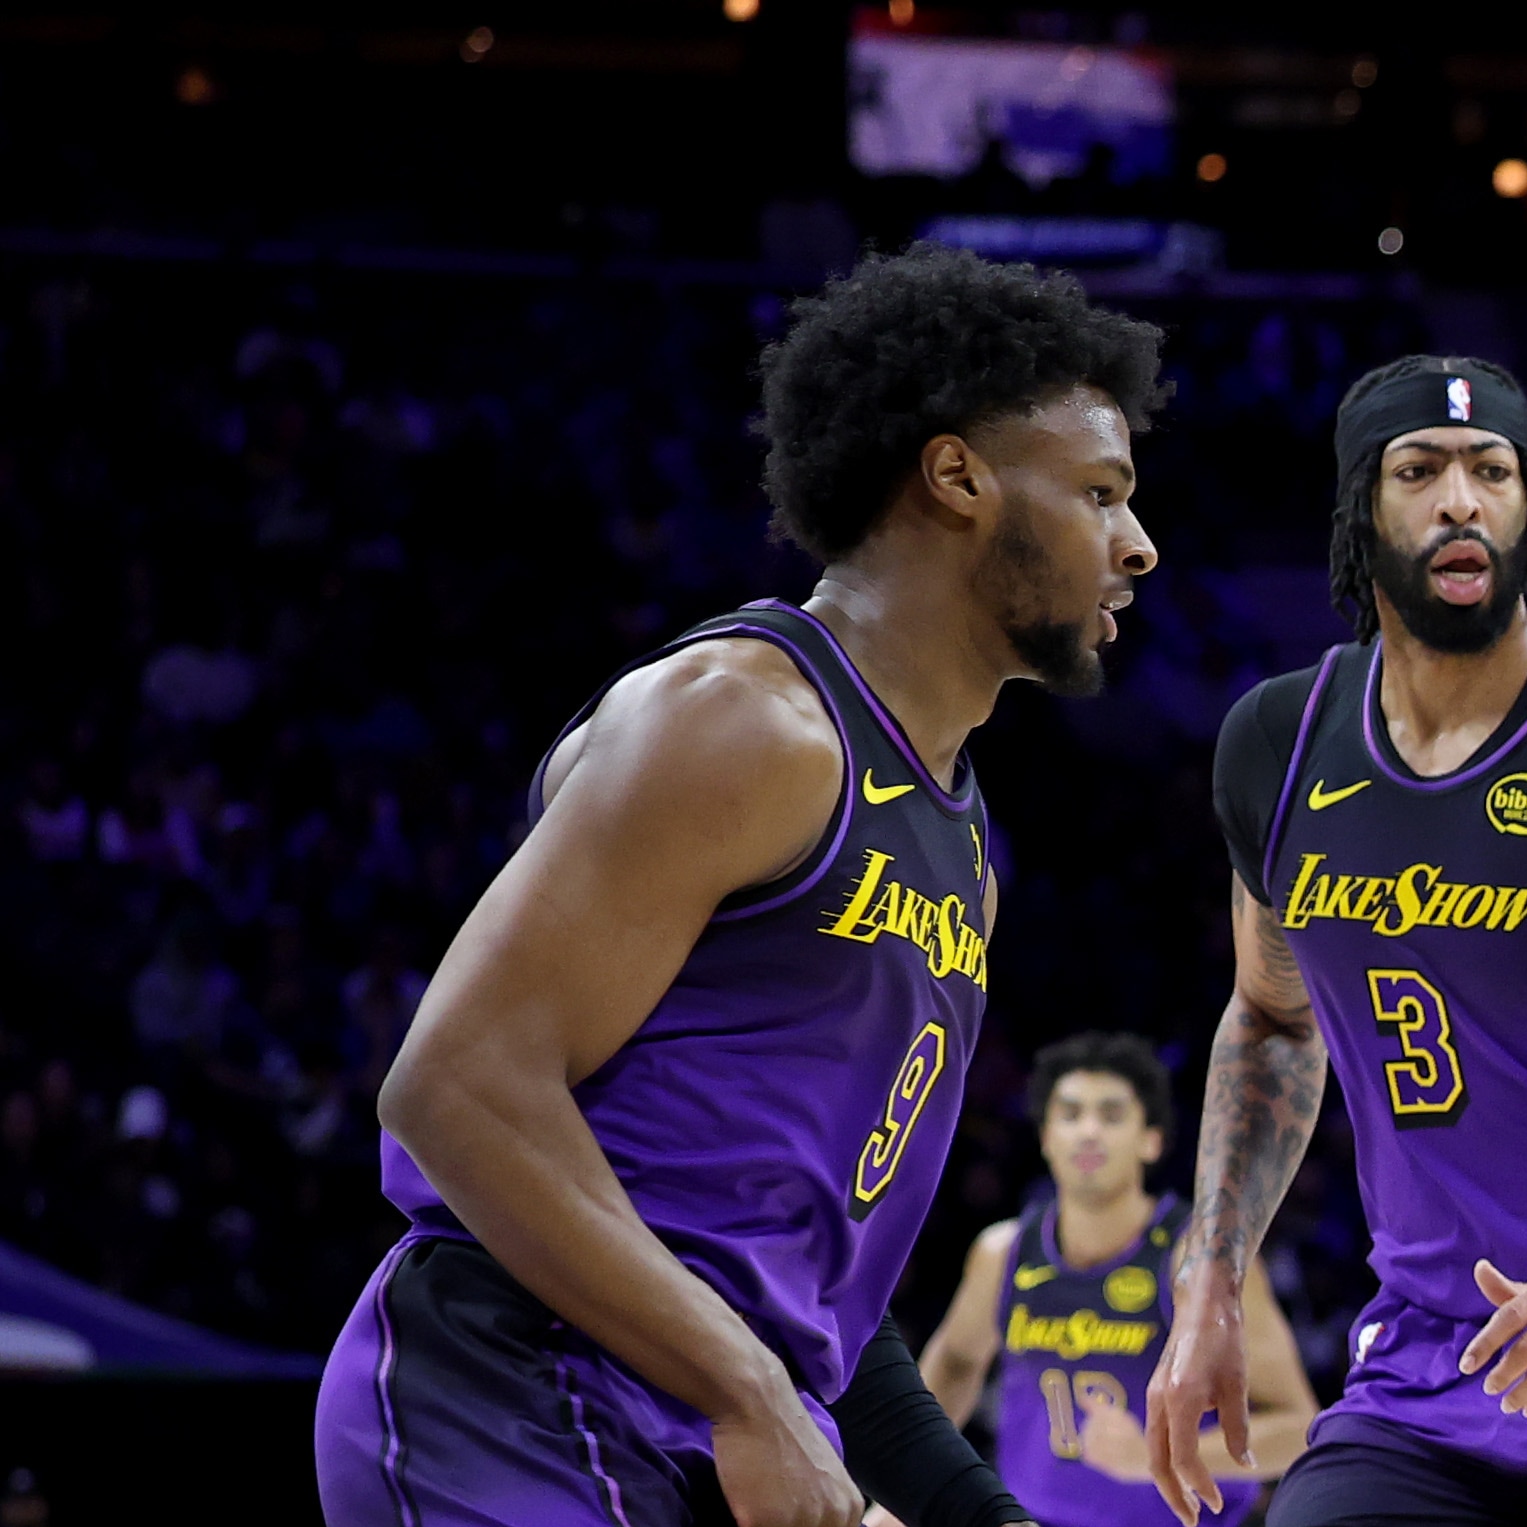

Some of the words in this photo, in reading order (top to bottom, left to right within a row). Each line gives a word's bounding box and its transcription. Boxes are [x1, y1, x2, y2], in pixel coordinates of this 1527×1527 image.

[817, 848, 988, 993] LAKESHO
[854, 1021, 946, 1205] 9
[1366, 968, 1466, 1130] 3
